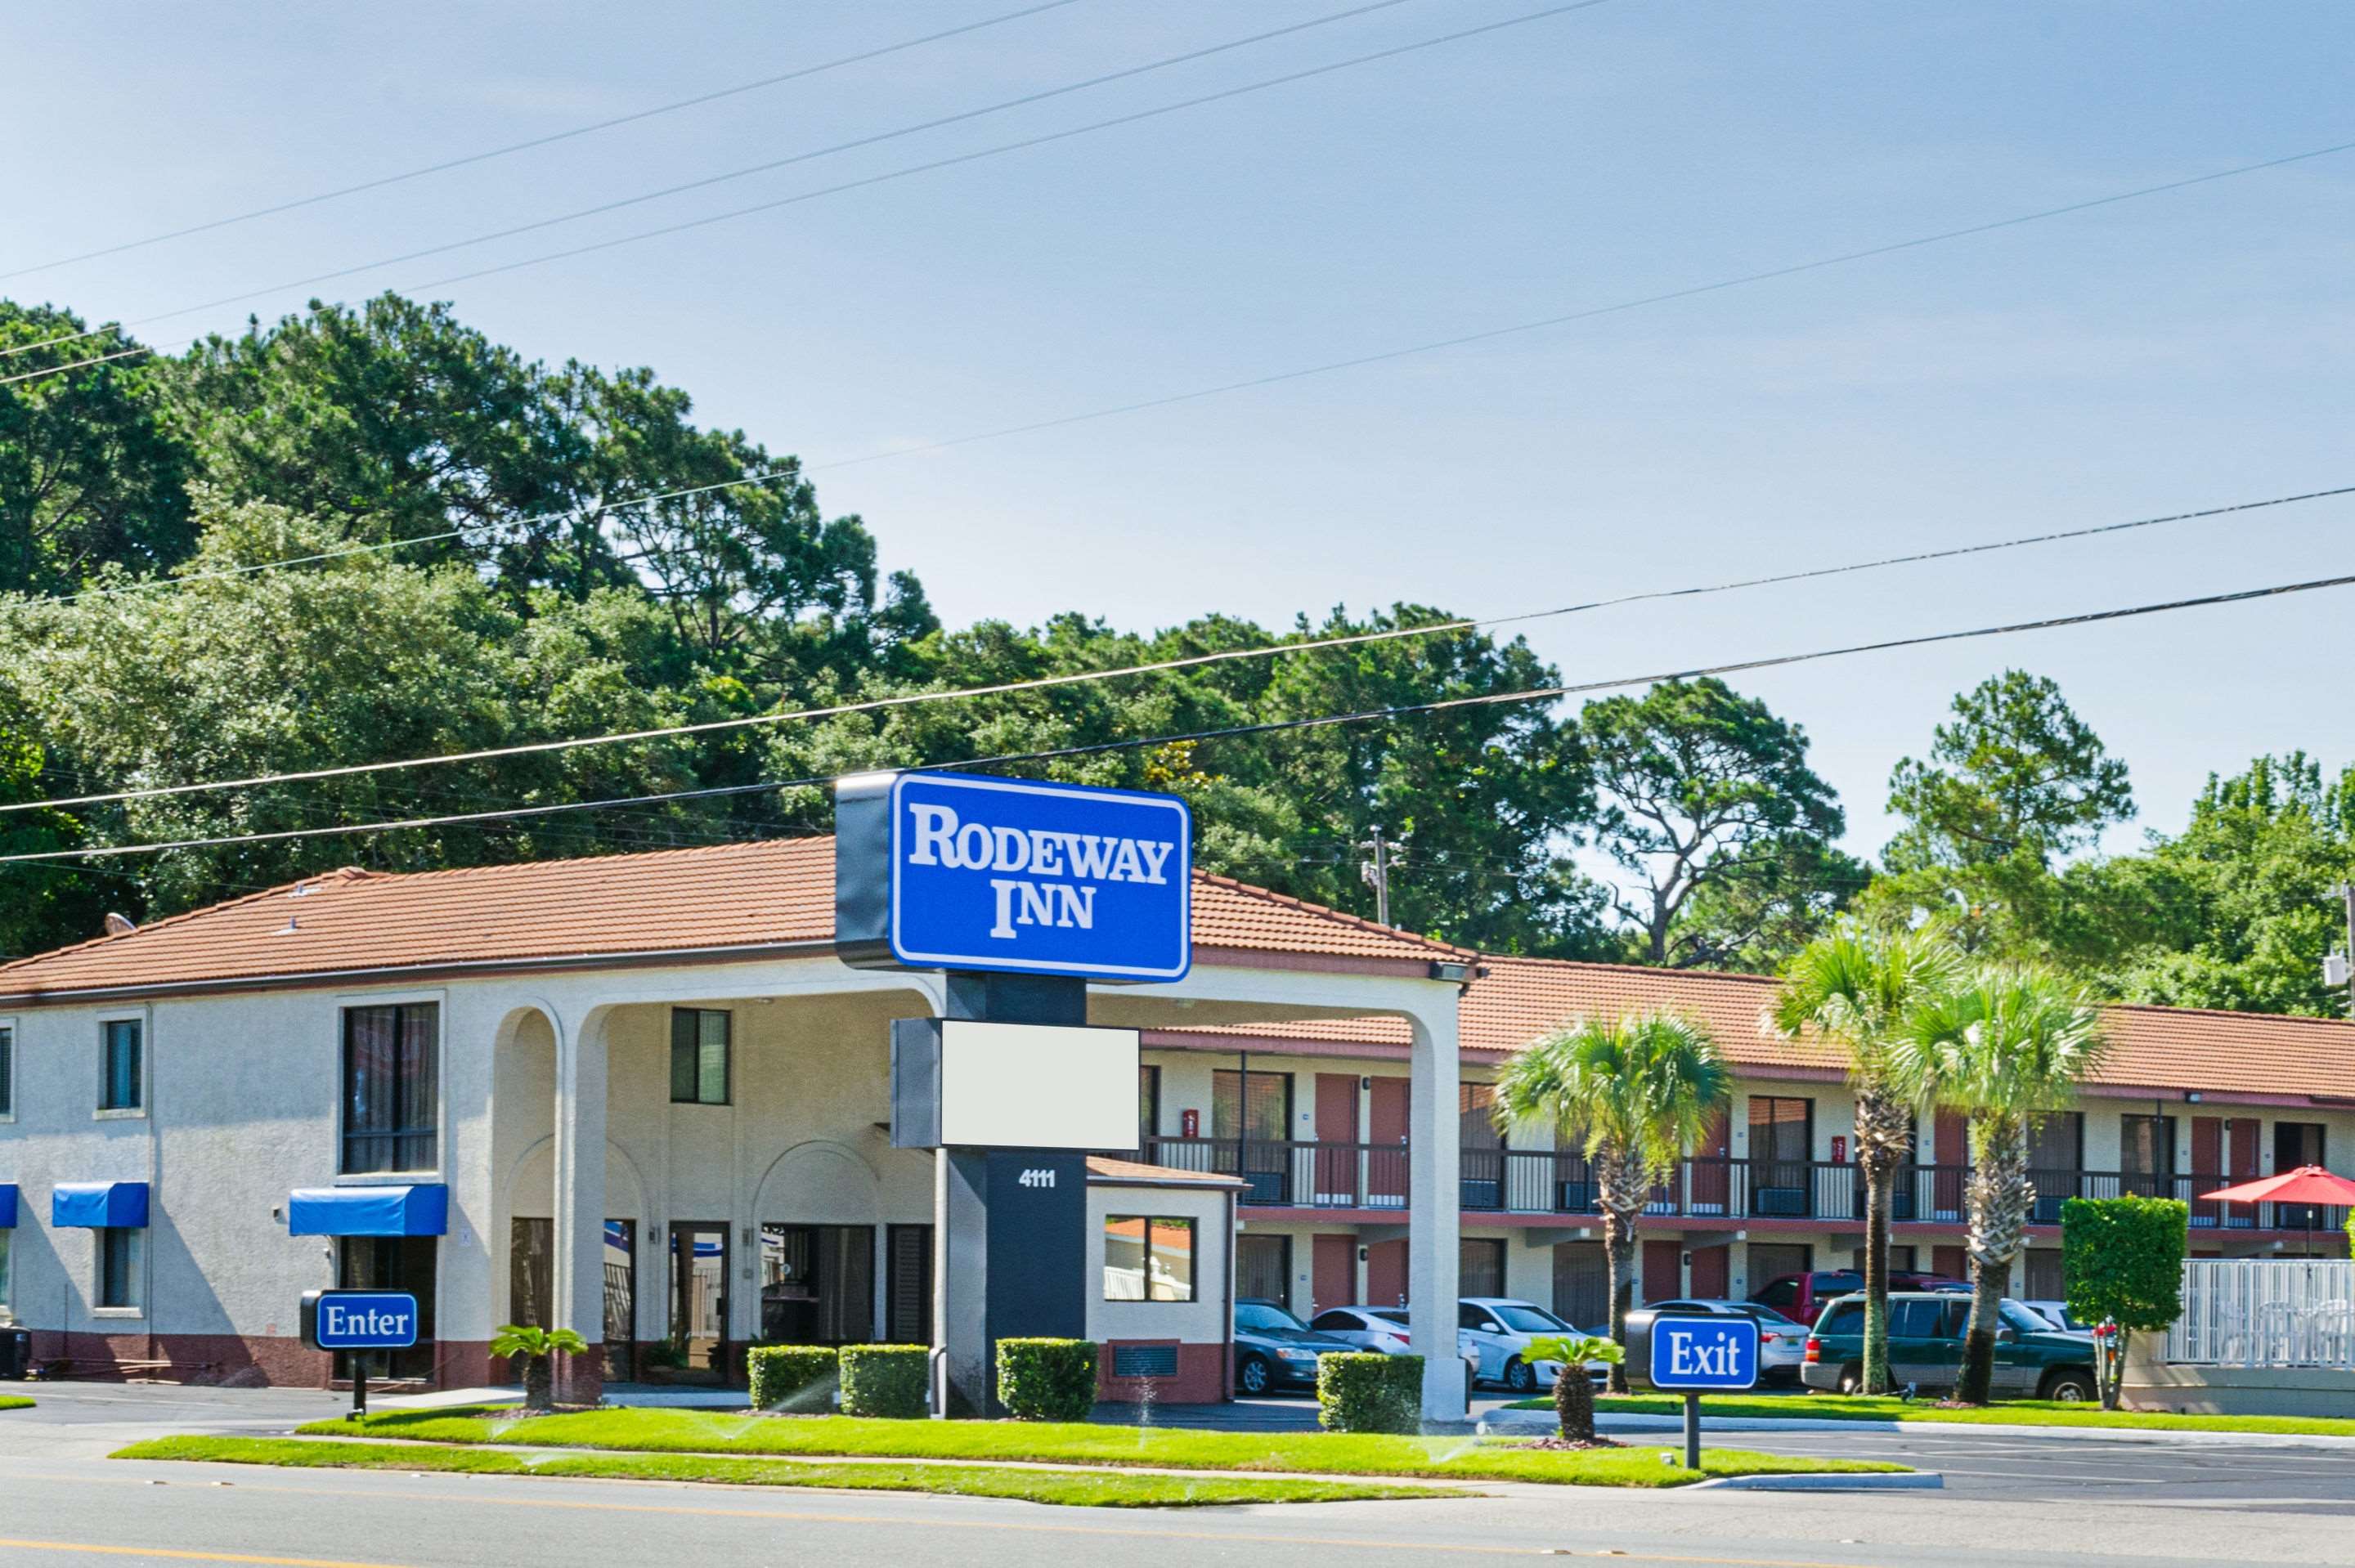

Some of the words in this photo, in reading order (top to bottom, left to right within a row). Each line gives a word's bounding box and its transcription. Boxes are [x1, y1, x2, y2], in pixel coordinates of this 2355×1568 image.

[908, 803, 1174, 885] RODEWAY
[990, 880, 1097, 939] INN
[1018, 1169, 1056, 1188] 4111
[326, 1306, 409, 1335] Enter
[1669, 1332, 1740, 1376] Exit
